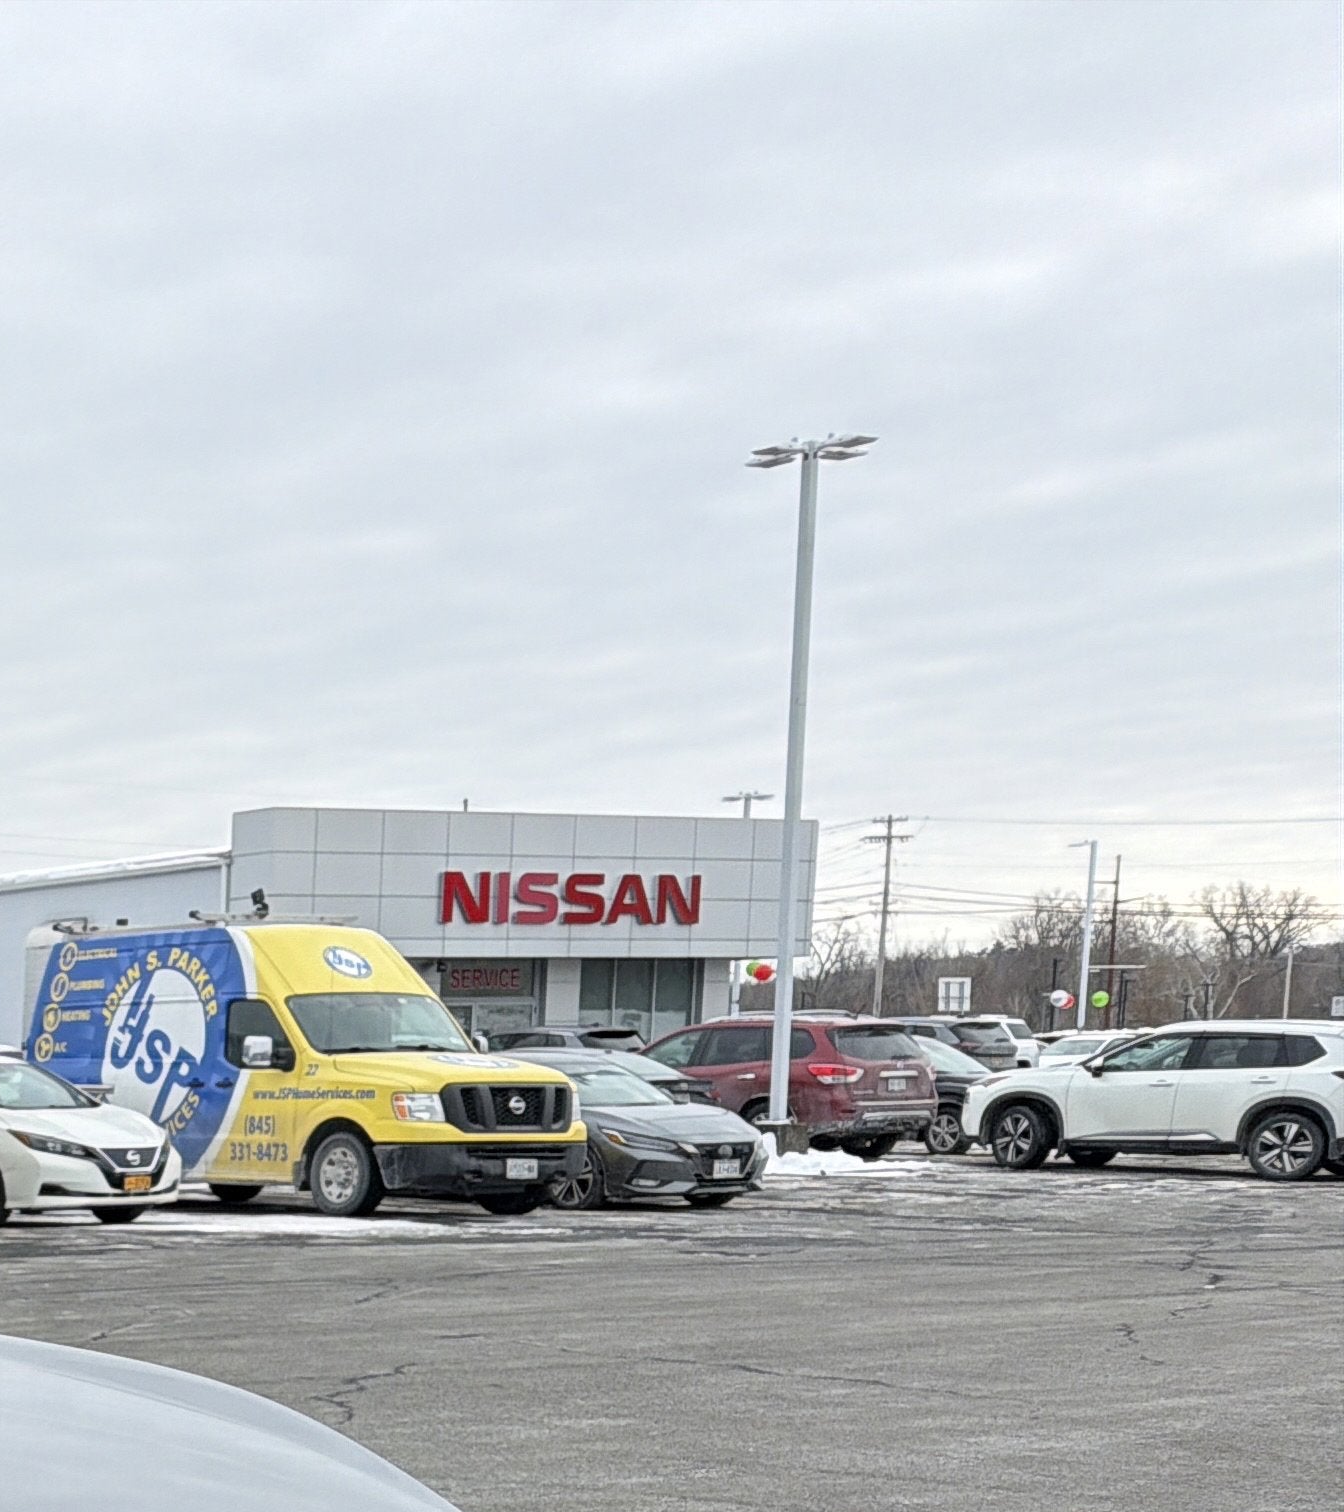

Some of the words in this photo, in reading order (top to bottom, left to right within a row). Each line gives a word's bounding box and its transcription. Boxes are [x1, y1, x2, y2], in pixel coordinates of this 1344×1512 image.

[440, 871, 702, 925] NISSAN
[102, 962, 140, 1026] JOHN
[146, 951, 162, 971] S.
[168, 948, 217, 1022] PARKER
[450, 968, 521, 989] SERVICE
[253, 1087, 375, 1100] www.JSPHomeServices.com
[244, 1115, 275, 1136] (845)
[230, 1143, 288, 1162] 331-8473
